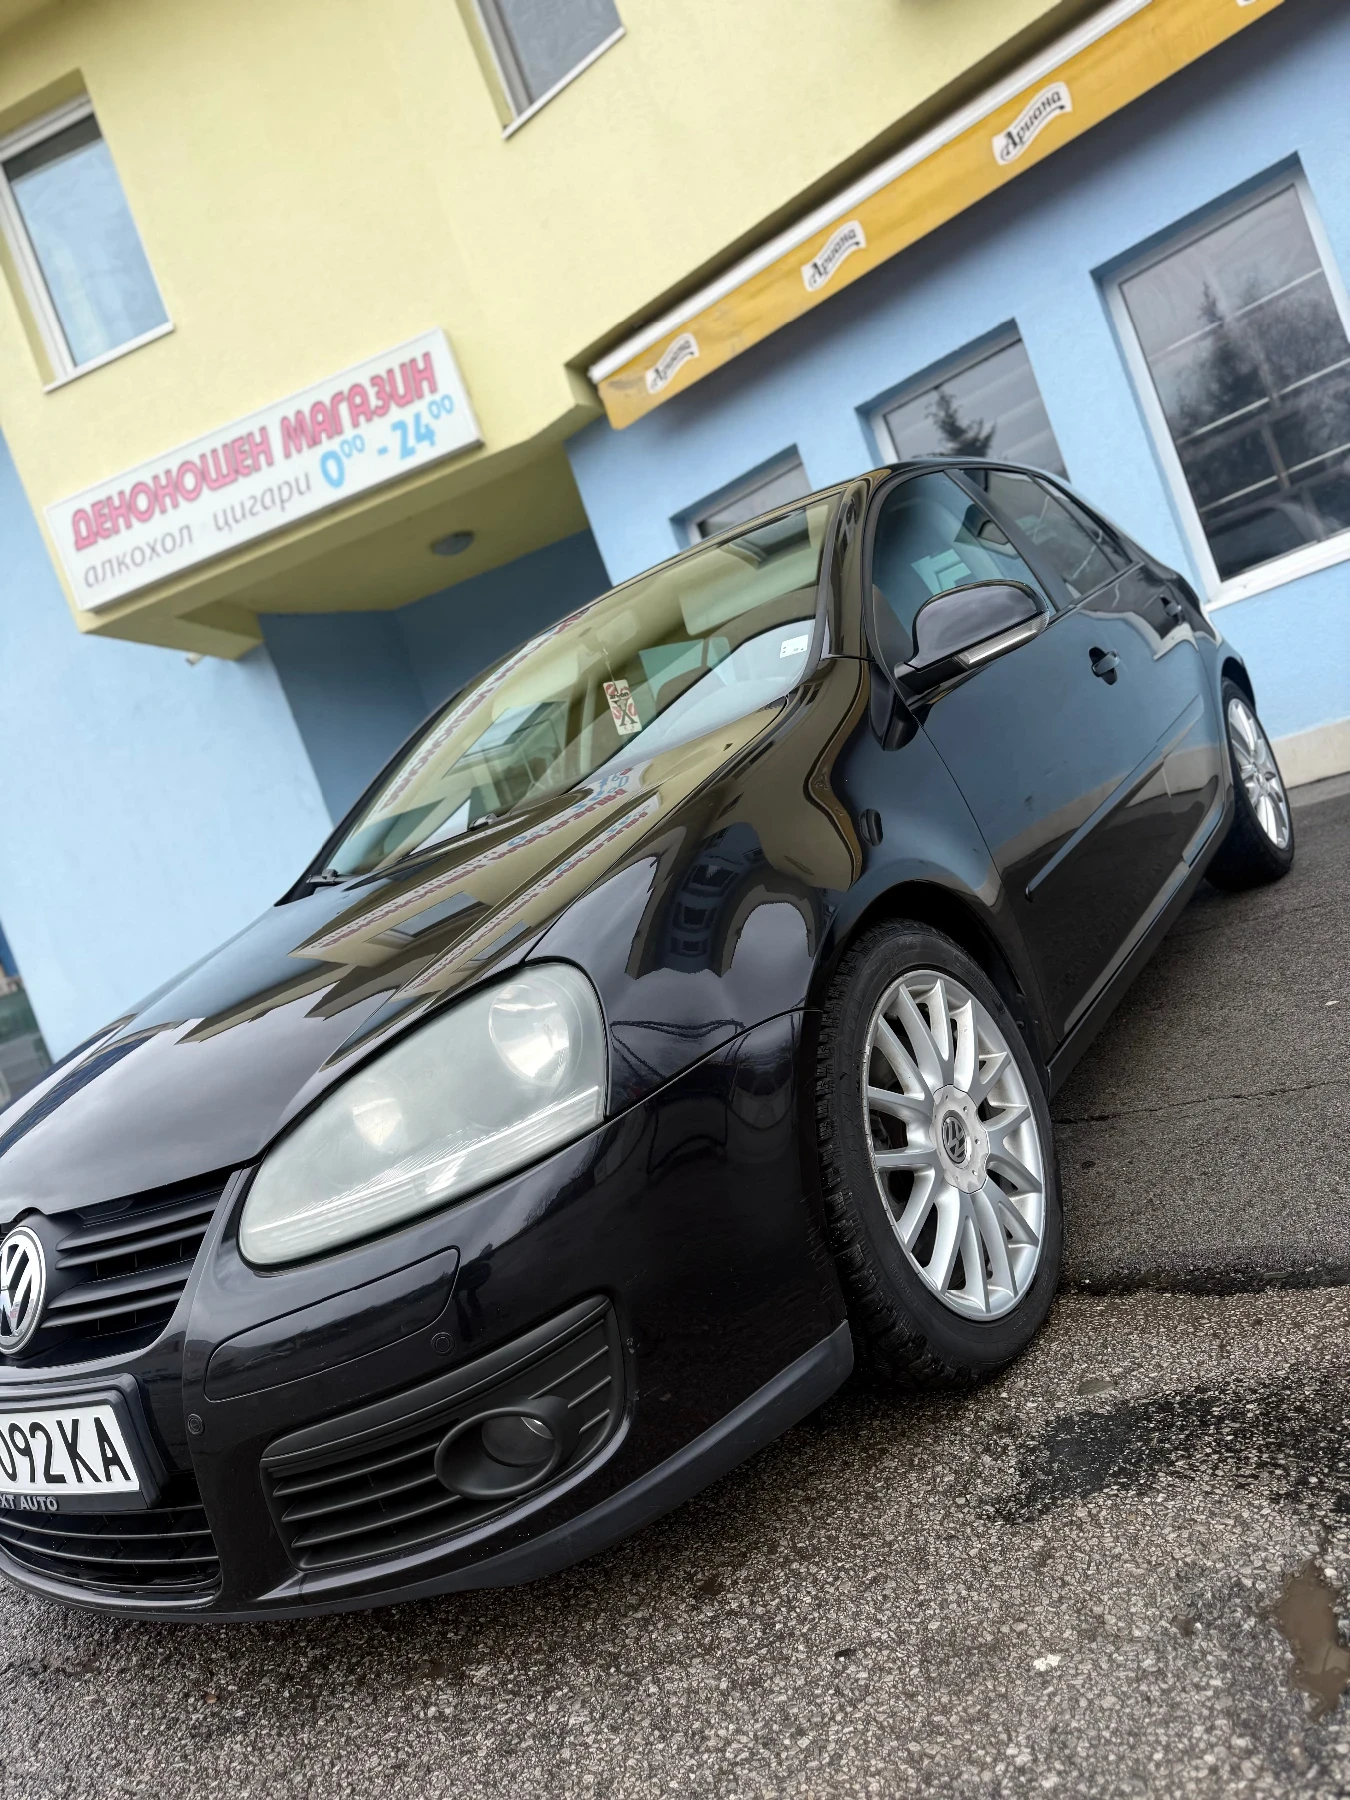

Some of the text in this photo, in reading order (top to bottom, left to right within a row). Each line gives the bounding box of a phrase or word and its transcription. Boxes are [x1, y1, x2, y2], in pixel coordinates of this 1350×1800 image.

[1000, 91, 1062, 162] Ариана
[280, 351, 438, 460] МАГАЗИН
[83, 471, 312, 588] алкохол цигари
[0, 1494, 58, 1511] XT AUTO
